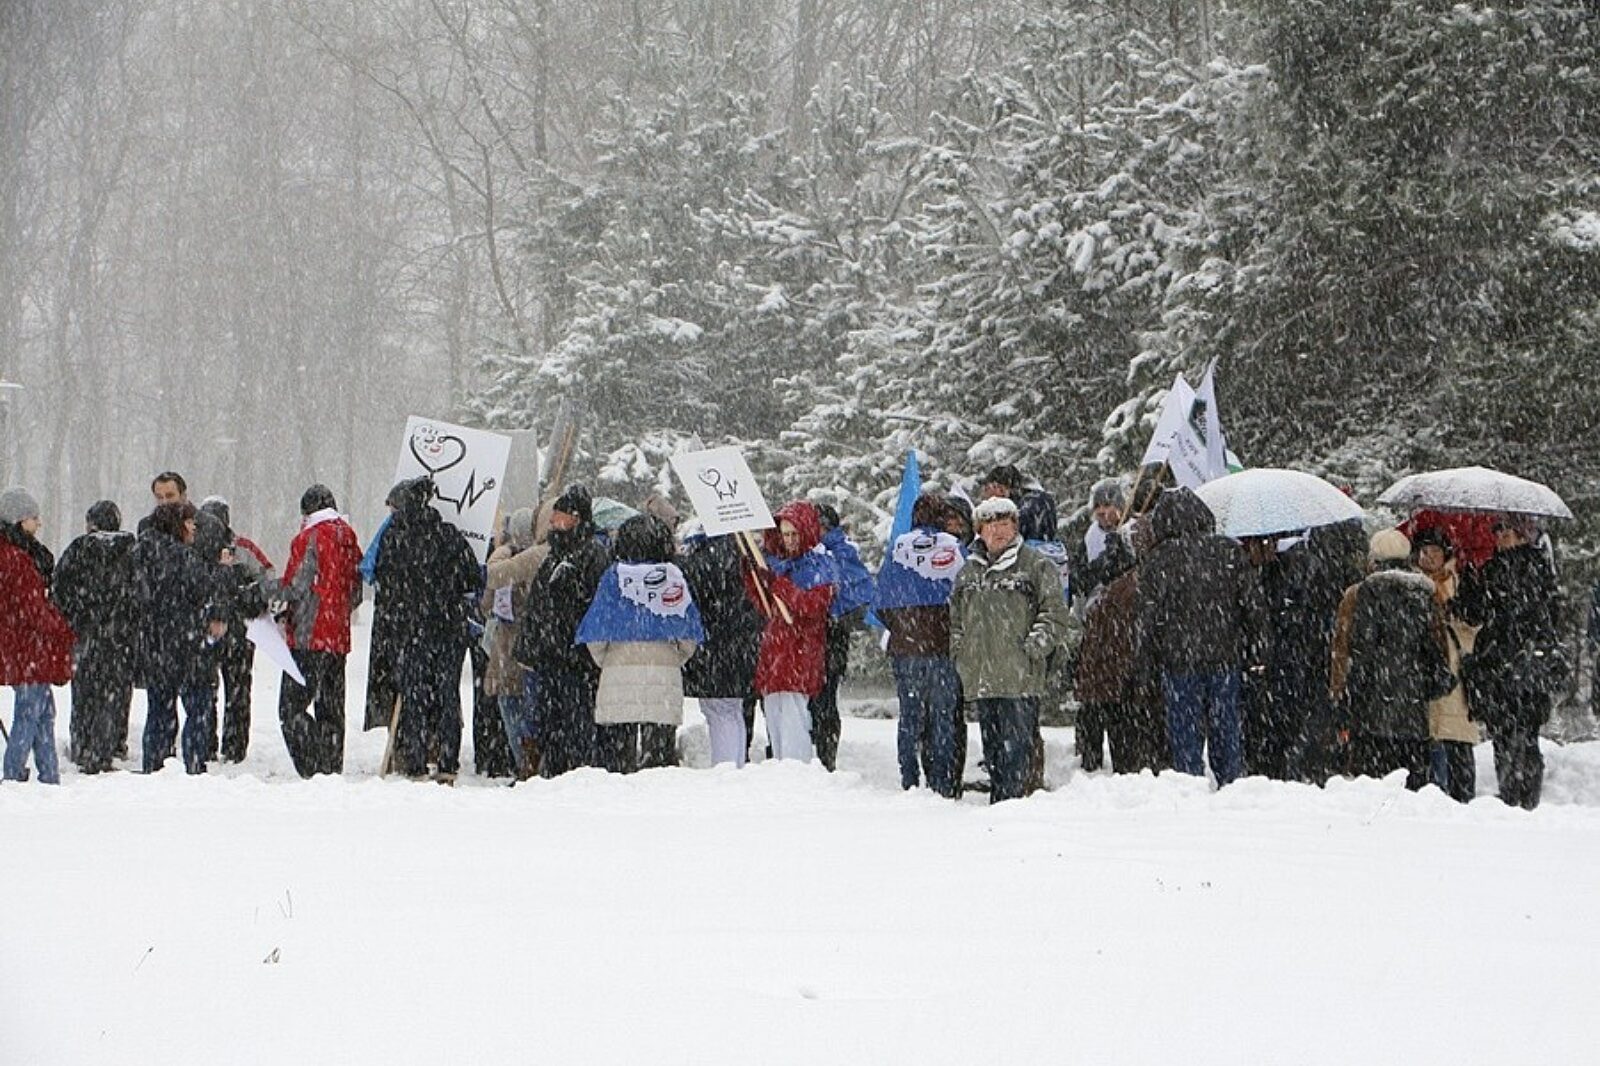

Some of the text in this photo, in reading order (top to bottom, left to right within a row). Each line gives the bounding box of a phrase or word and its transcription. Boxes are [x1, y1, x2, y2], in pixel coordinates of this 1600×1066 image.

[917, 555, 925, 566] P
[624, 577, 633, 588] P
[648, 591, 657, 602] P
